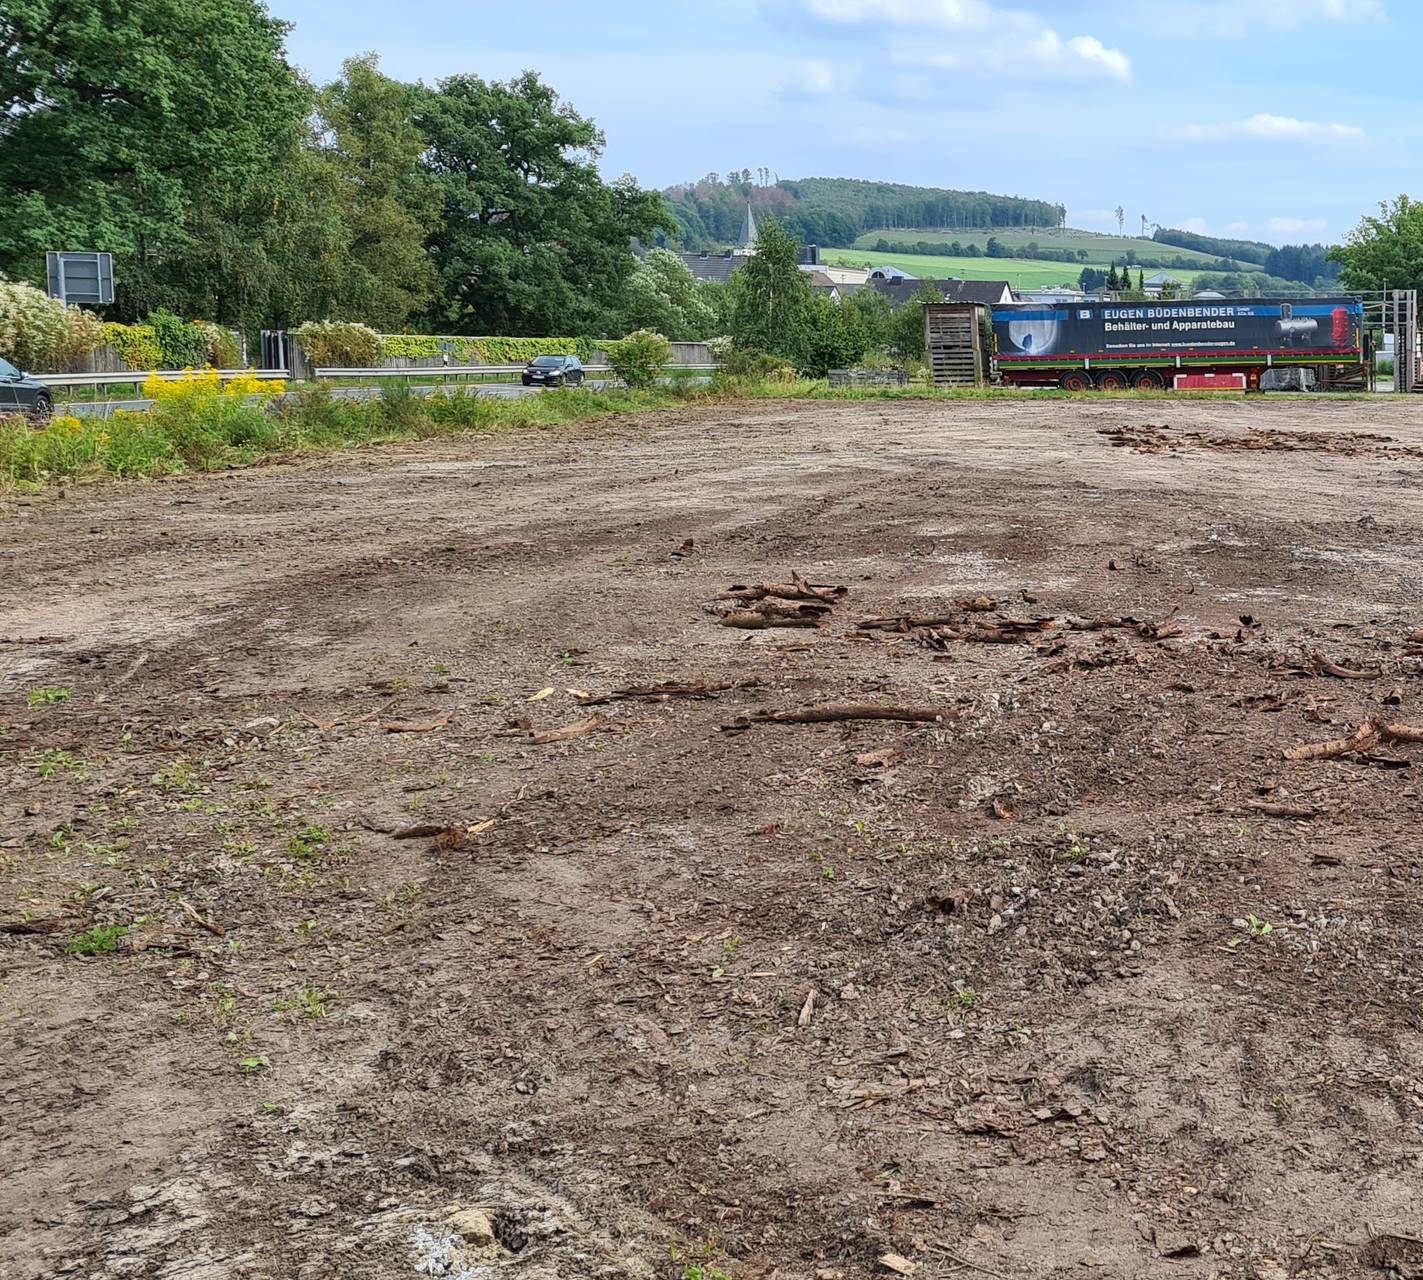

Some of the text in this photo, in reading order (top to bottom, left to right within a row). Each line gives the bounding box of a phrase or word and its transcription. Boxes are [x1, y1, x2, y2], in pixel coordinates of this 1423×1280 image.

[1104, 307, 1235, 320] EUGEN BÜDENBENDER
[1104, 319, 1236, 332] Behälter- und Apparatebau
